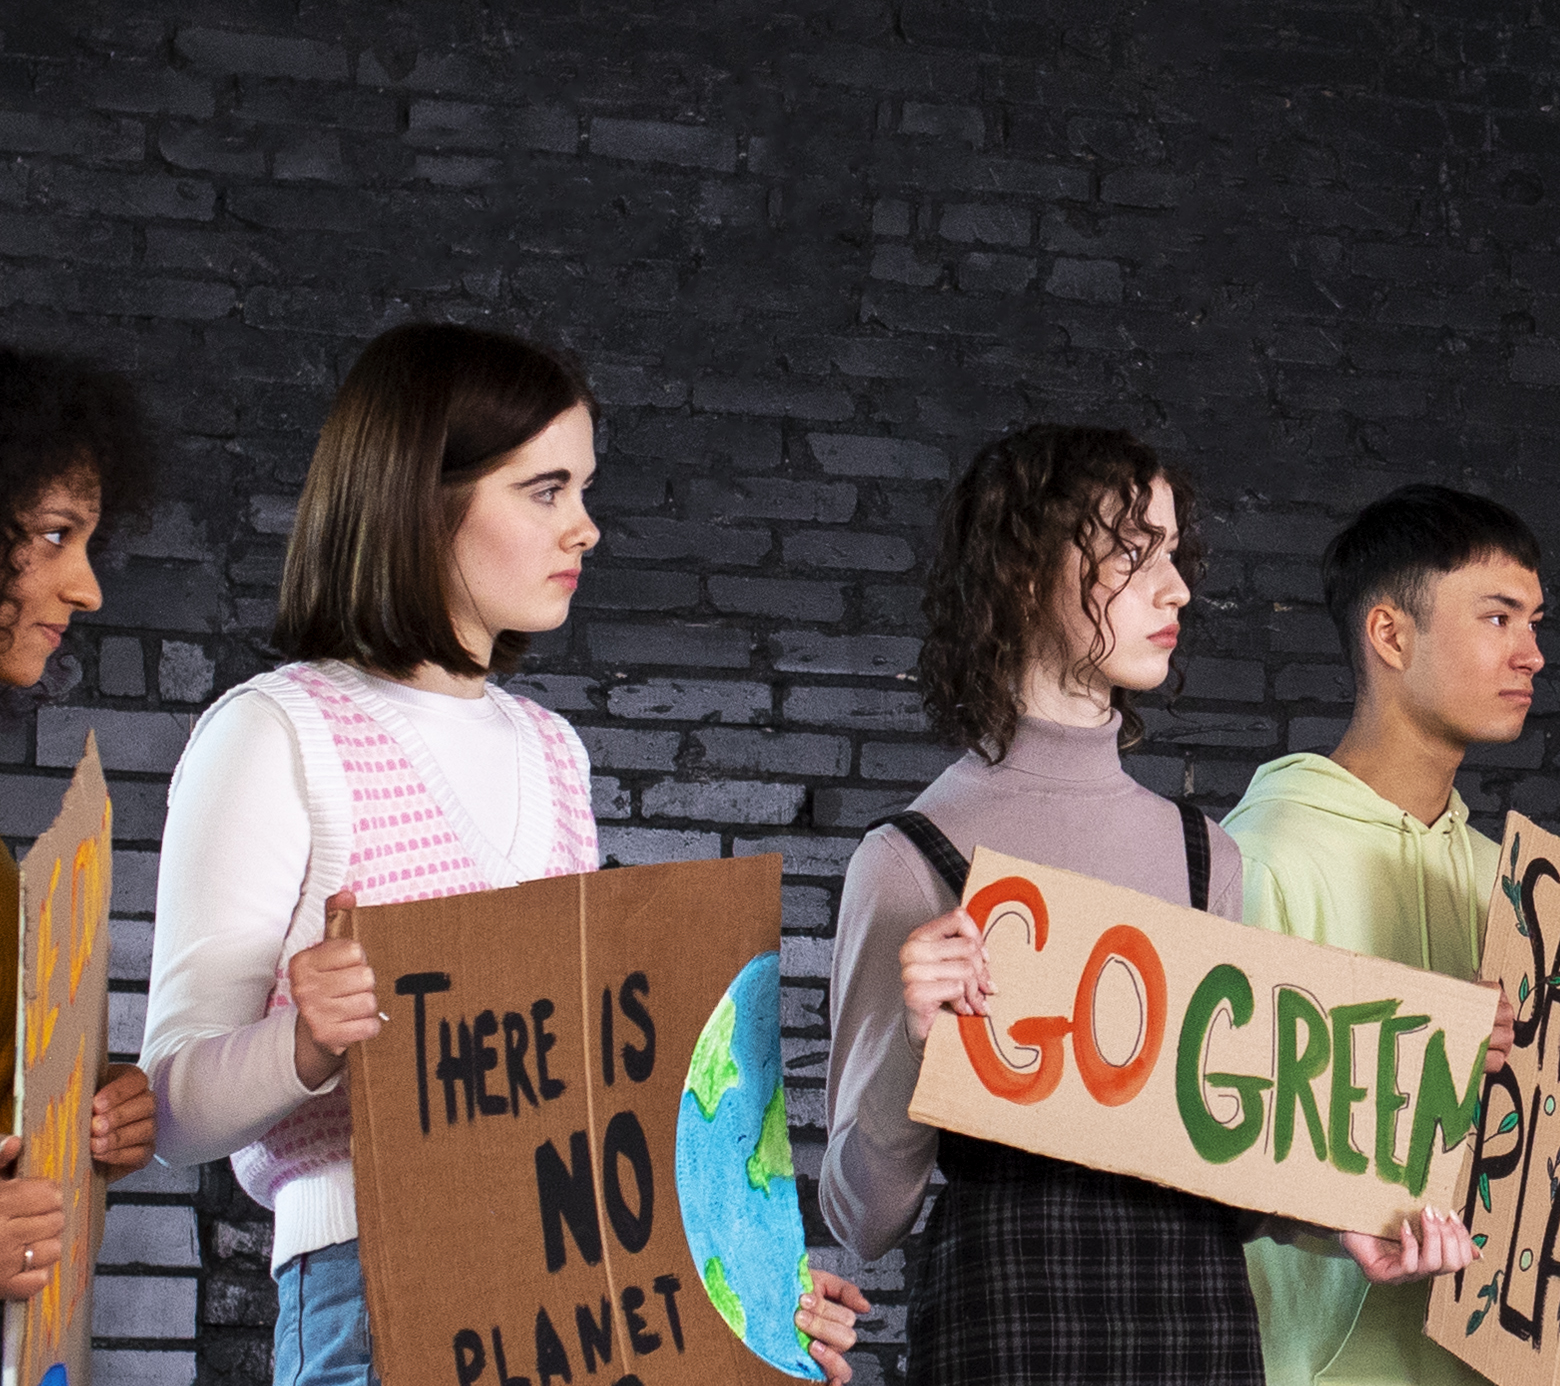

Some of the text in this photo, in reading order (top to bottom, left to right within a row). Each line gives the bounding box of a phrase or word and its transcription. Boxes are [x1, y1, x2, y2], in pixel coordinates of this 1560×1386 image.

[394, 970, 657, 1137] THERE IS
[956, 875, 1491, 1198] GO GREEN
[534, 1110, 655, 1274] NO
